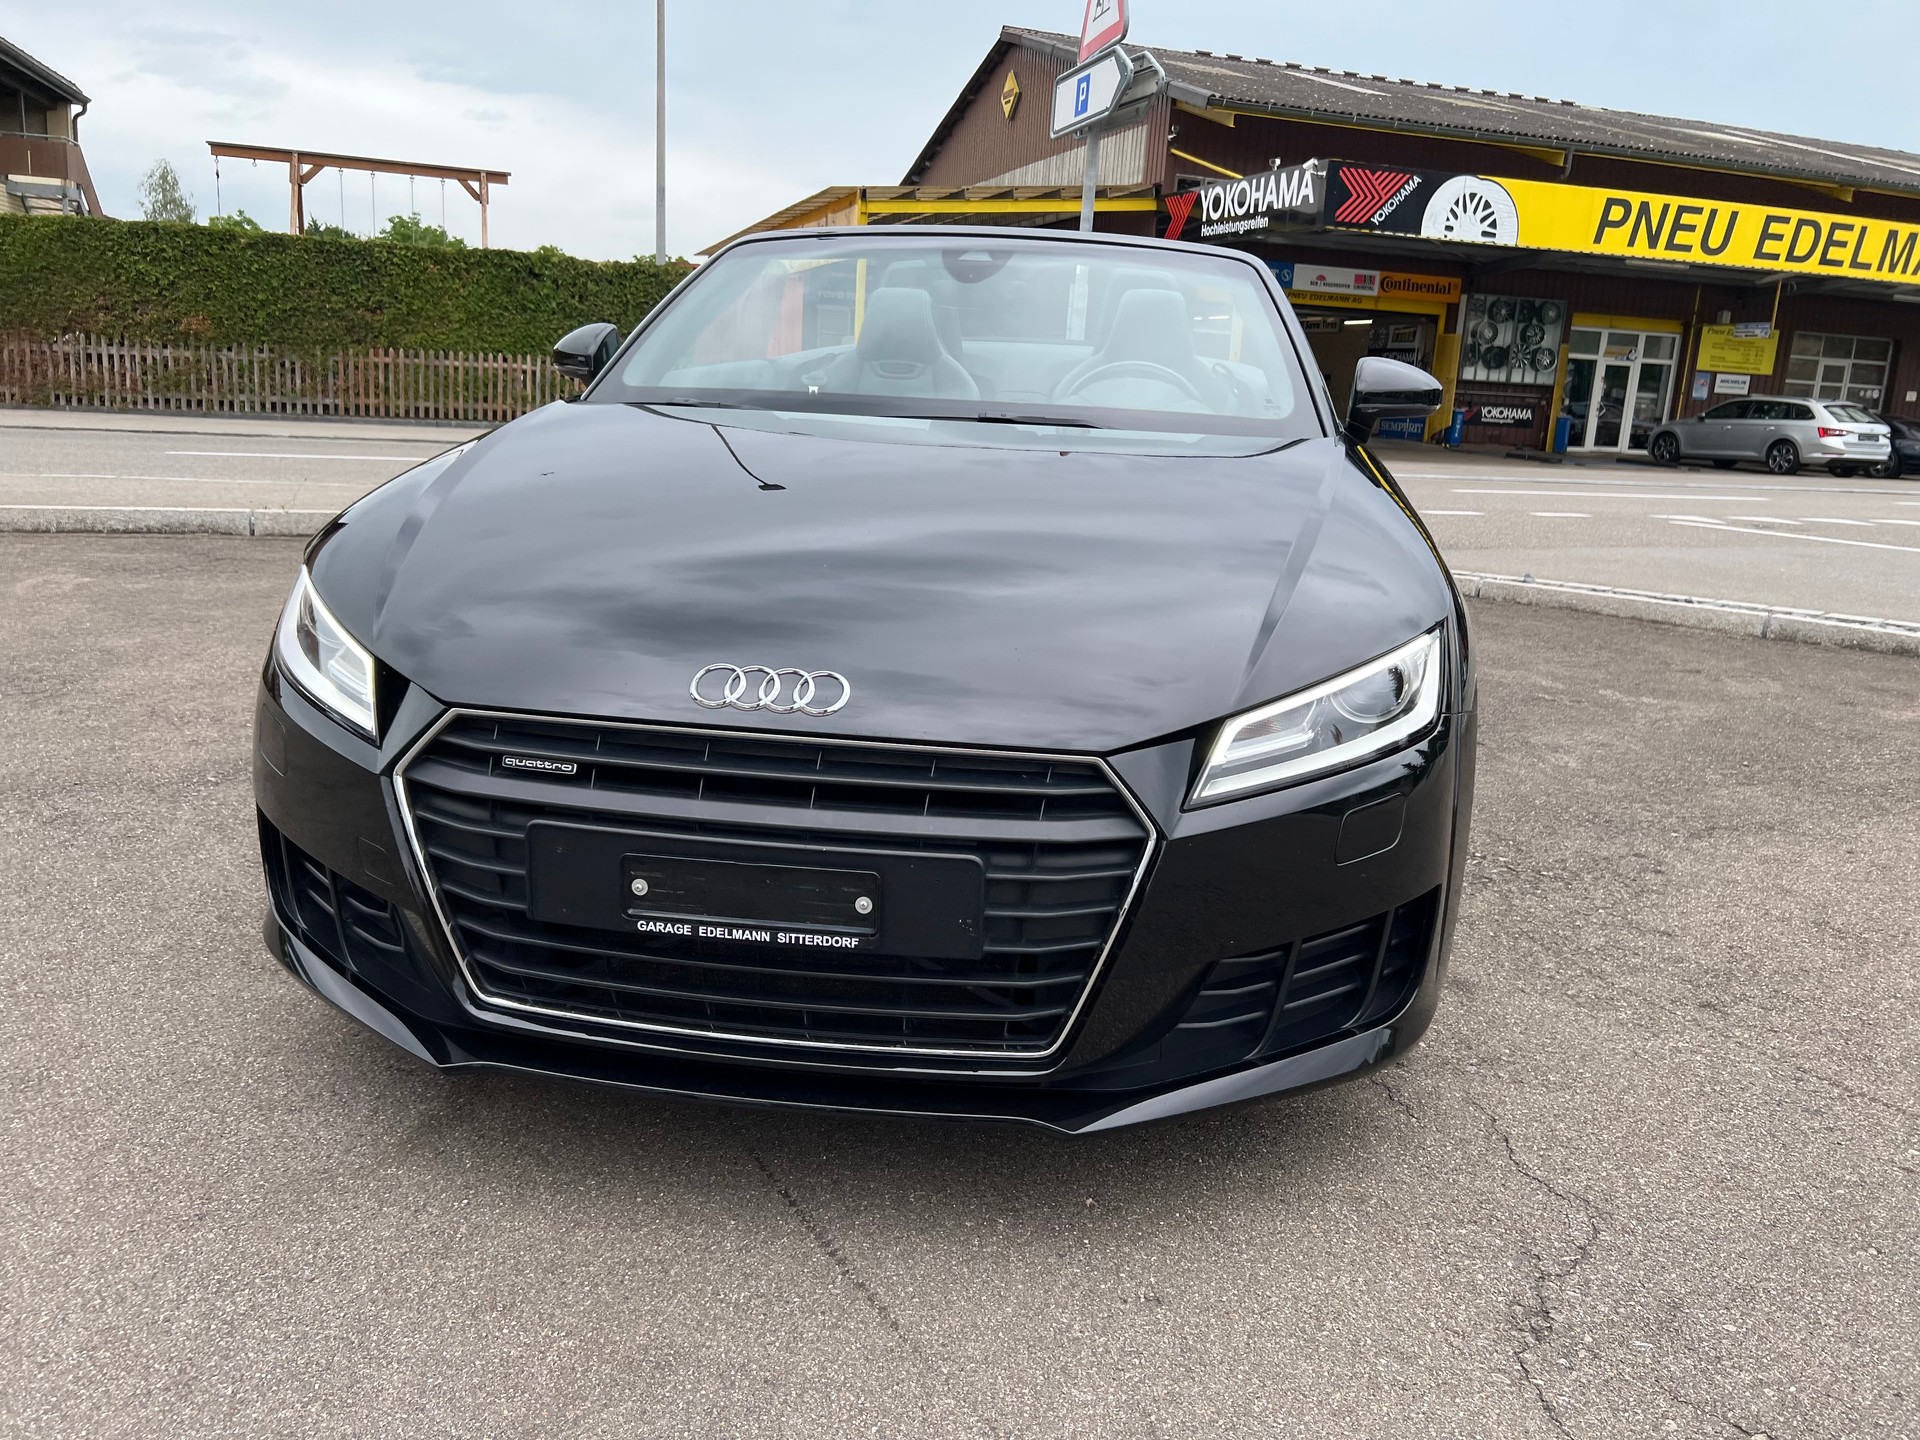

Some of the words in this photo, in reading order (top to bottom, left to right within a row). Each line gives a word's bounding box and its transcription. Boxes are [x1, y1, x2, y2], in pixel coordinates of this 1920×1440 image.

[1078, 81, 1088, 112] P
[1200, 169, 1314, 222] YOKOHAMA
[1370, 175, 1423, 226] YOKOHAMA
[1201, 215, 1269, 237] Hochleistungsreifen
[1593, 197, 1739, 256] PNEU
[1380, 276, 1452, 295] Continental
[1309, 293, 1350, 304] EDELMANN
[1481, 405, 1532, 420] YOKOHAMA
[505, 757, 572, 771] quattro
[637, 920, 692, 935] GARAGE
[699, 926, 770, 942] EDELMANN
[777, 932, 859, 949] SITTERDORF
